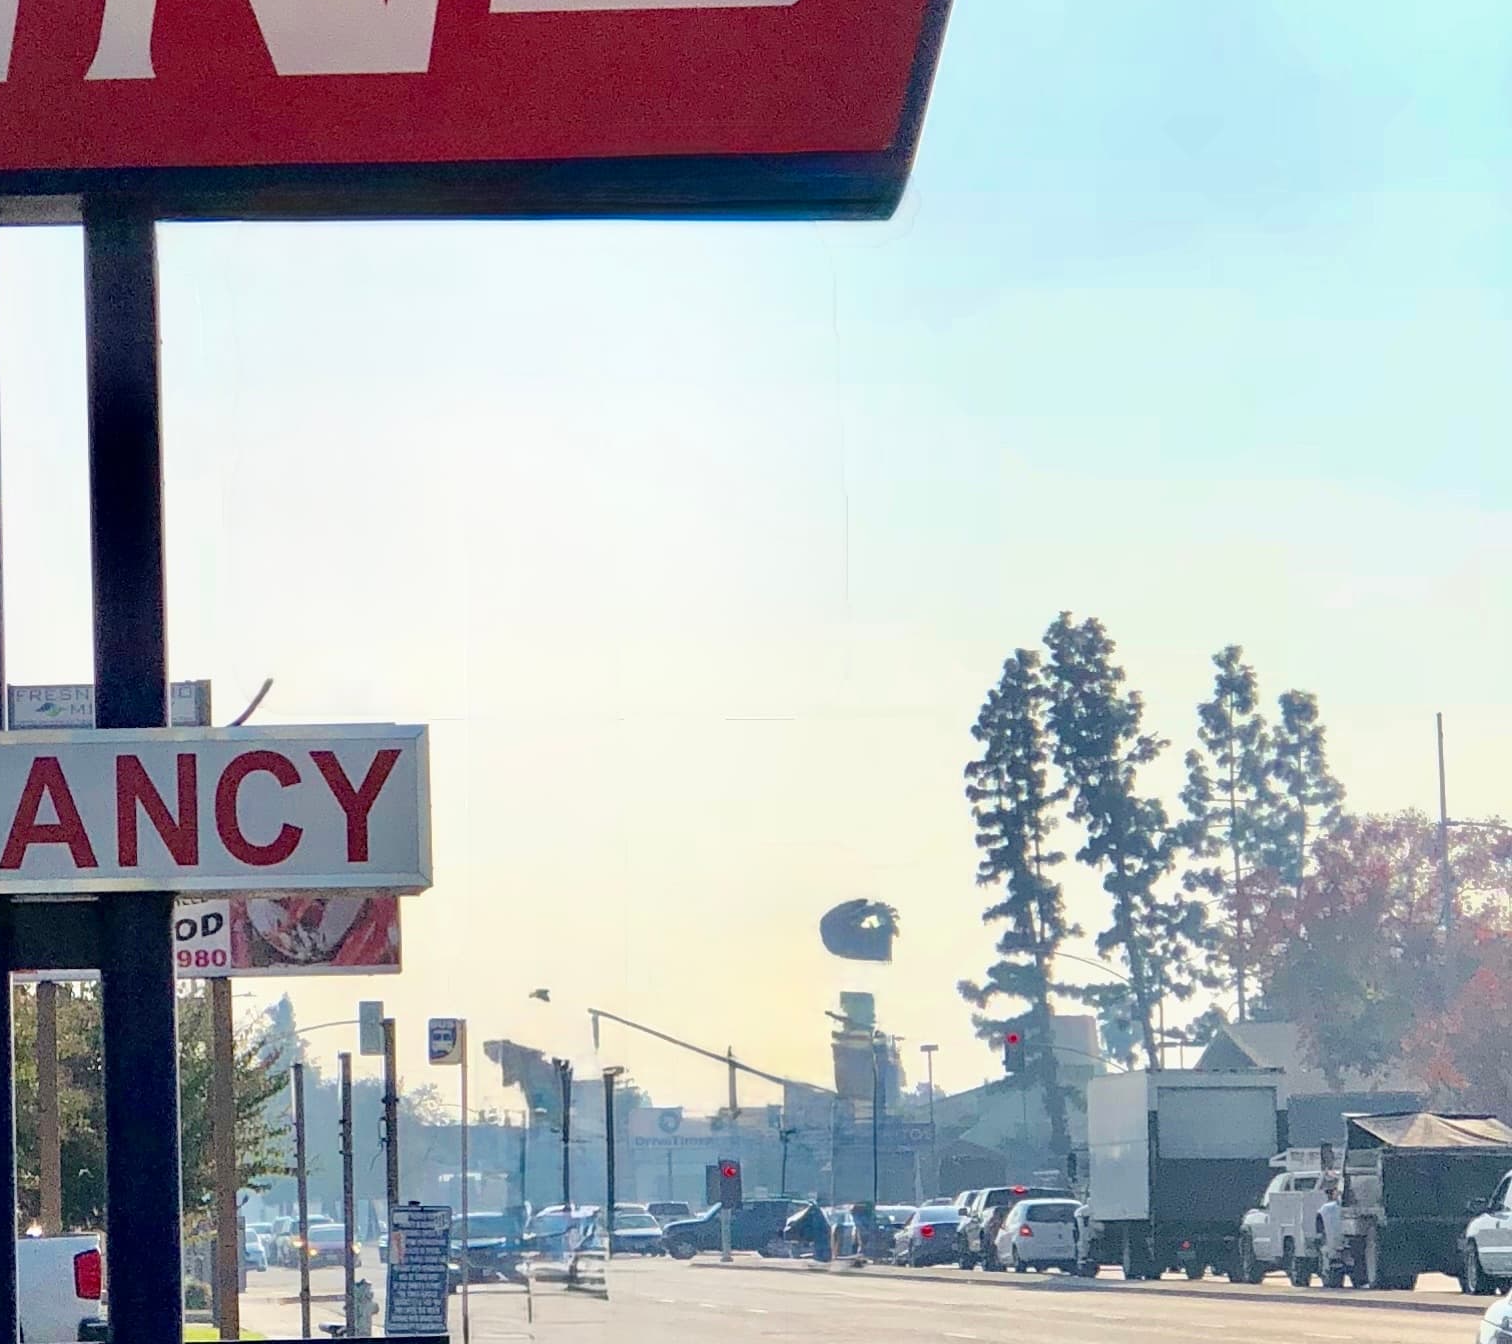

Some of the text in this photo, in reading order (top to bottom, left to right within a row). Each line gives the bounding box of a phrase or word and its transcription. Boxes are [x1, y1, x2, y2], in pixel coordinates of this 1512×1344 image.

[16, 688, 89, 702] FRESN
[175, 912, 223, 941] OD
[176, 949, 227, 967] 980
